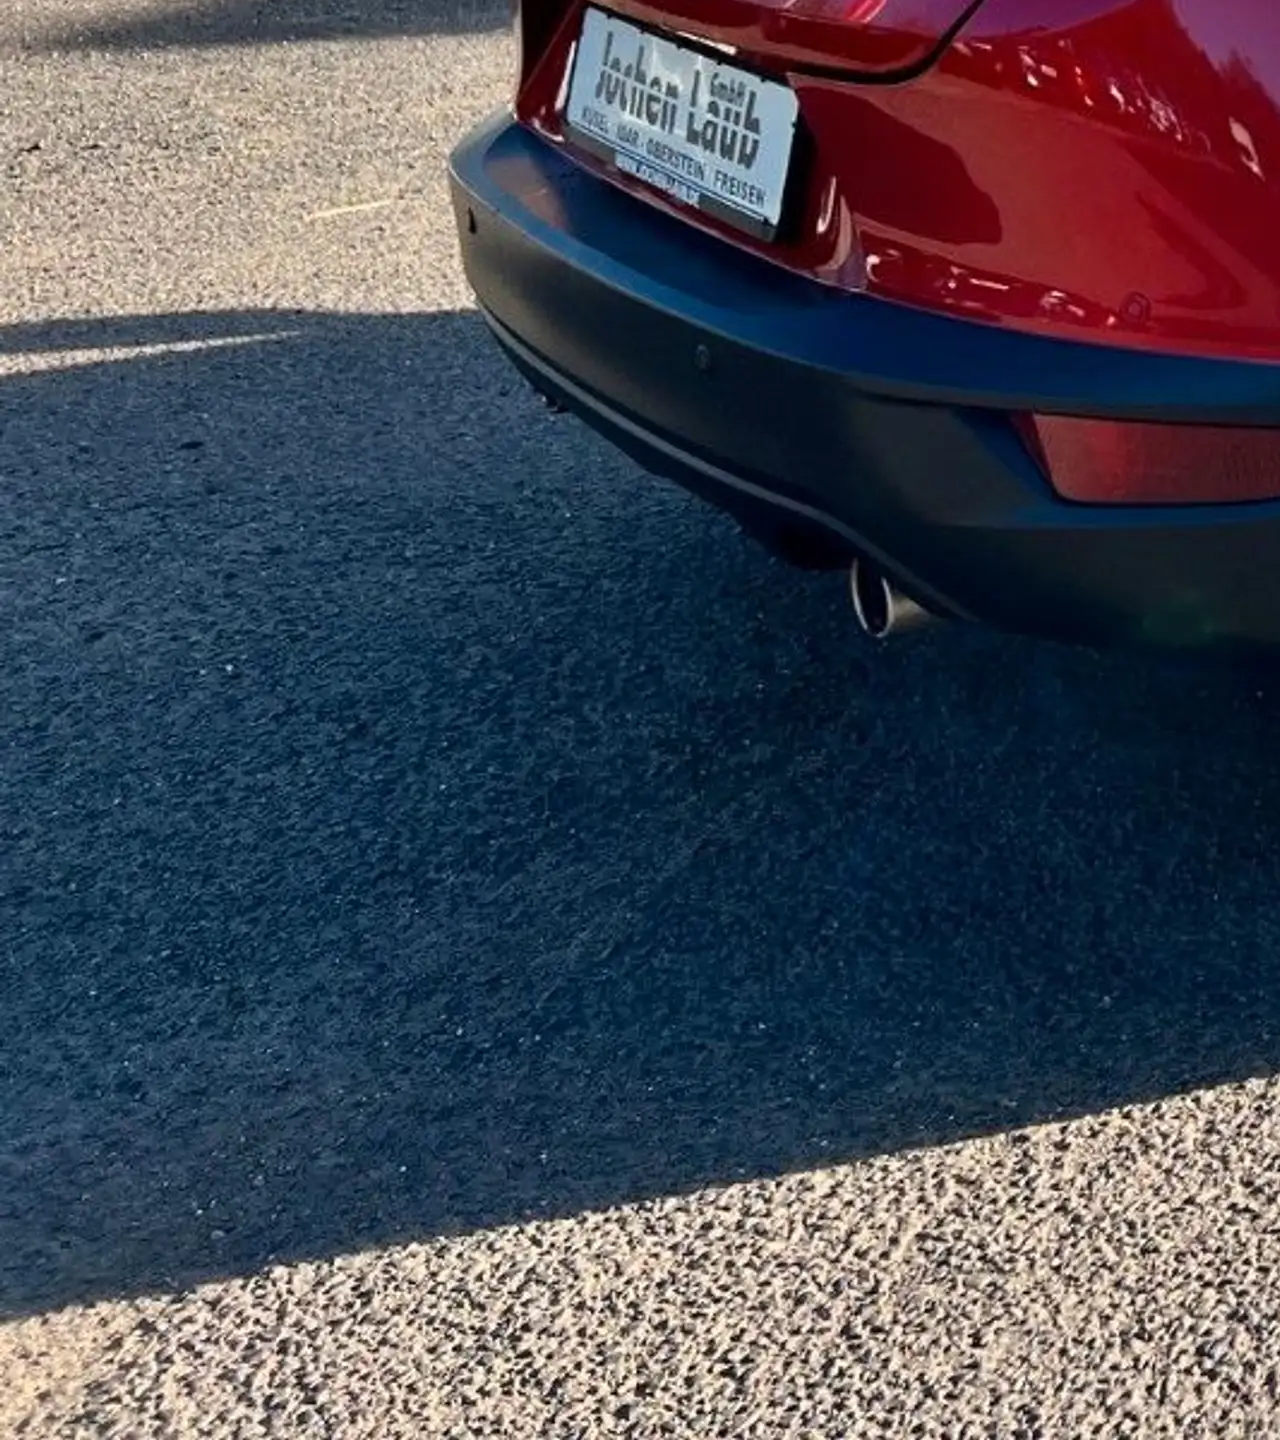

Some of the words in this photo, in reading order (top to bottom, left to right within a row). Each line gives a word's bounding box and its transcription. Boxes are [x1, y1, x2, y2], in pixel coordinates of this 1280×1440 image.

[595, 31, 680, 135] Jochen
[686, 69, 761, 170] Laub
[714, 166, 766, 208] FREISEN
